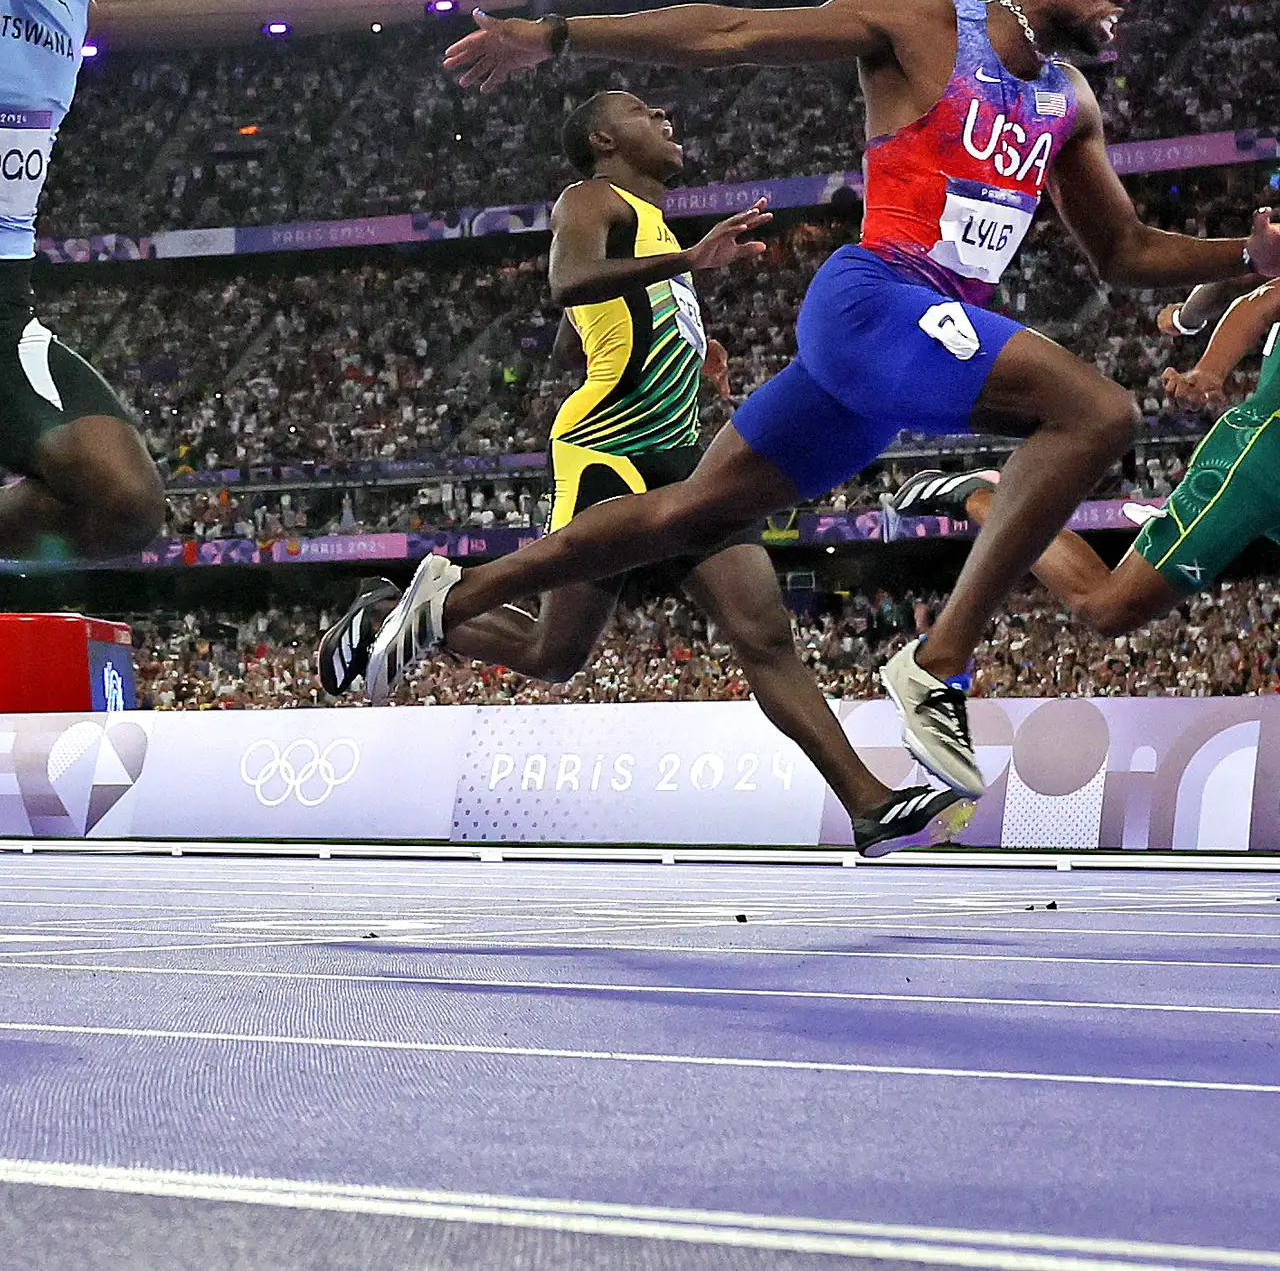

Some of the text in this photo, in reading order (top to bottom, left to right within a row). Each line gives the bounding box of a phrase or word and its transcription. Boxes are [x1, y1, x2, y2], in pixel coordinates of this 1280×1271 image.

[961, 98, 1053, 186] USA
[1112, 149, 1144, 166] RIS
[488, 751, 796, 792] PARIS 2024
